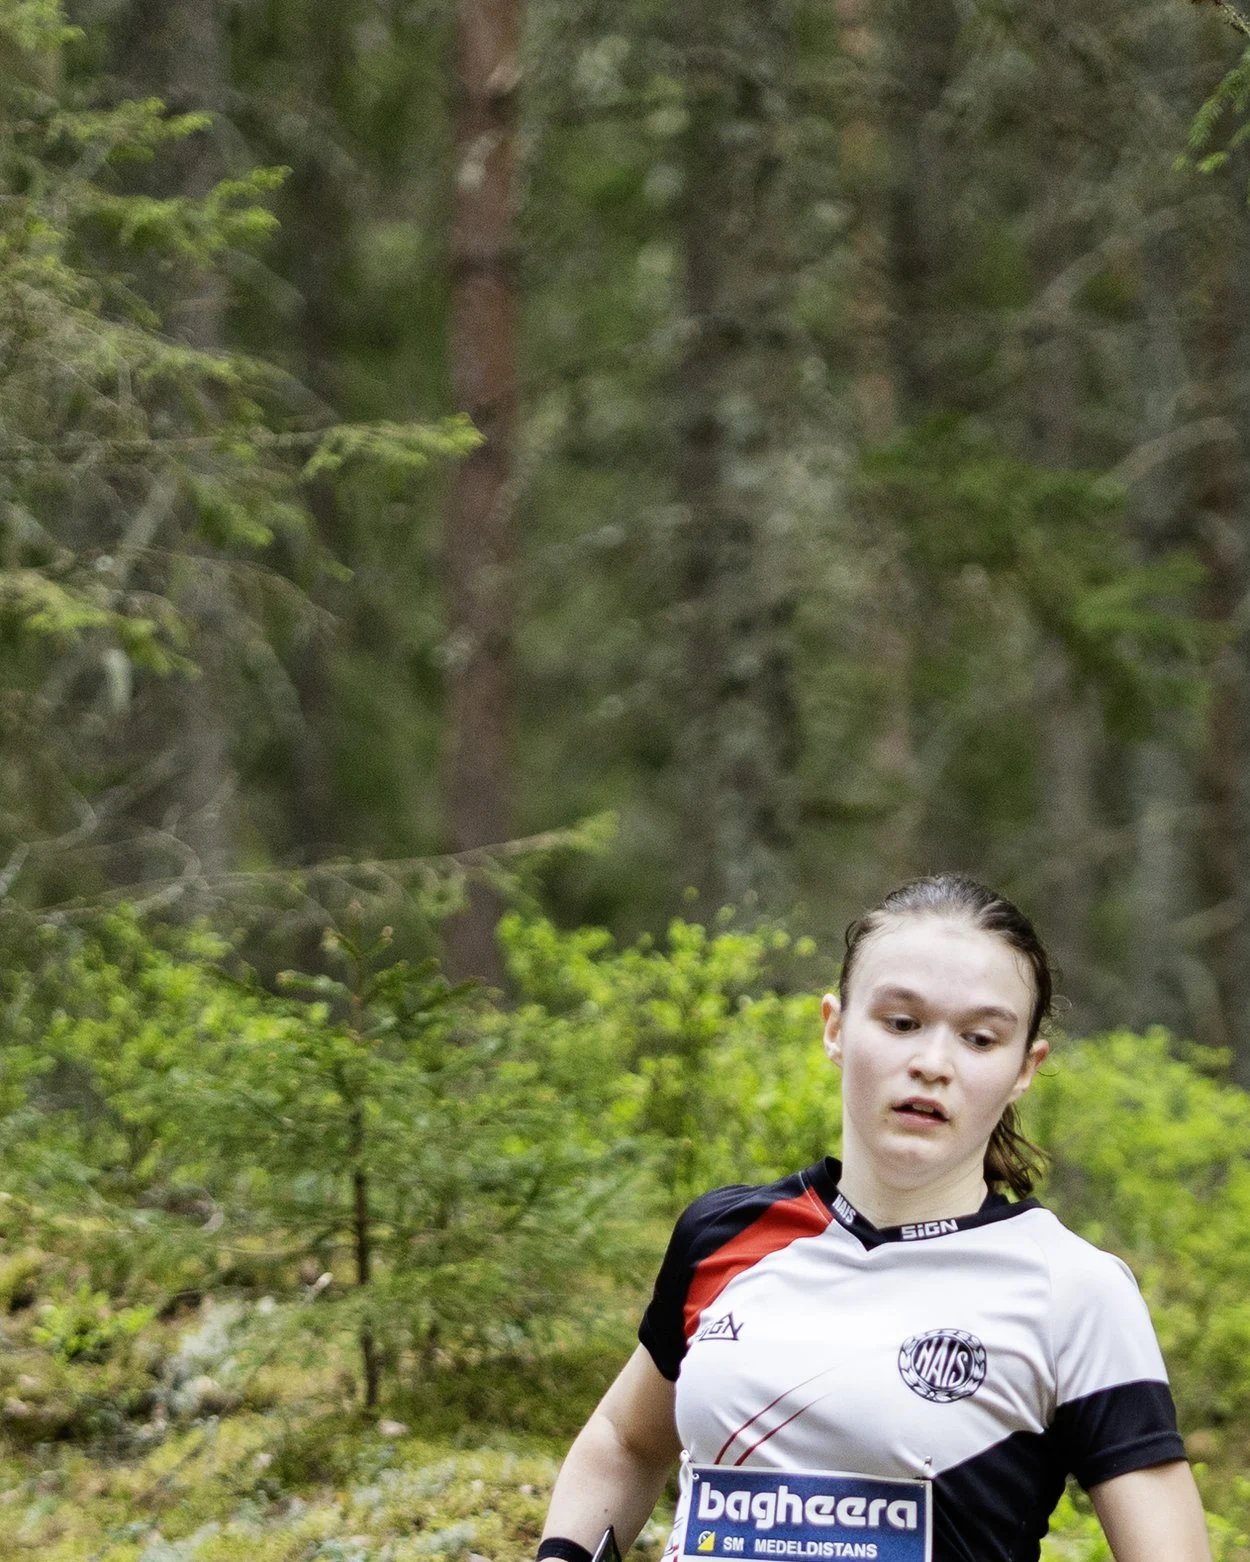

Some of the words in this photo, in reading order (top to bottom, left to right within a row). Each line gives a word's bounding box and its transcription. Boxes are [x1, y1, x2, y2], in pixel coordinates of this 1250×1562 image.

[831, 1194, 857, 1224] NAIS
[697, 1482, 918, 1530] bagheera
[723, 1536, 745, 1552] SM
[754, 1537, 878, 1558] MEDELDISTANS
